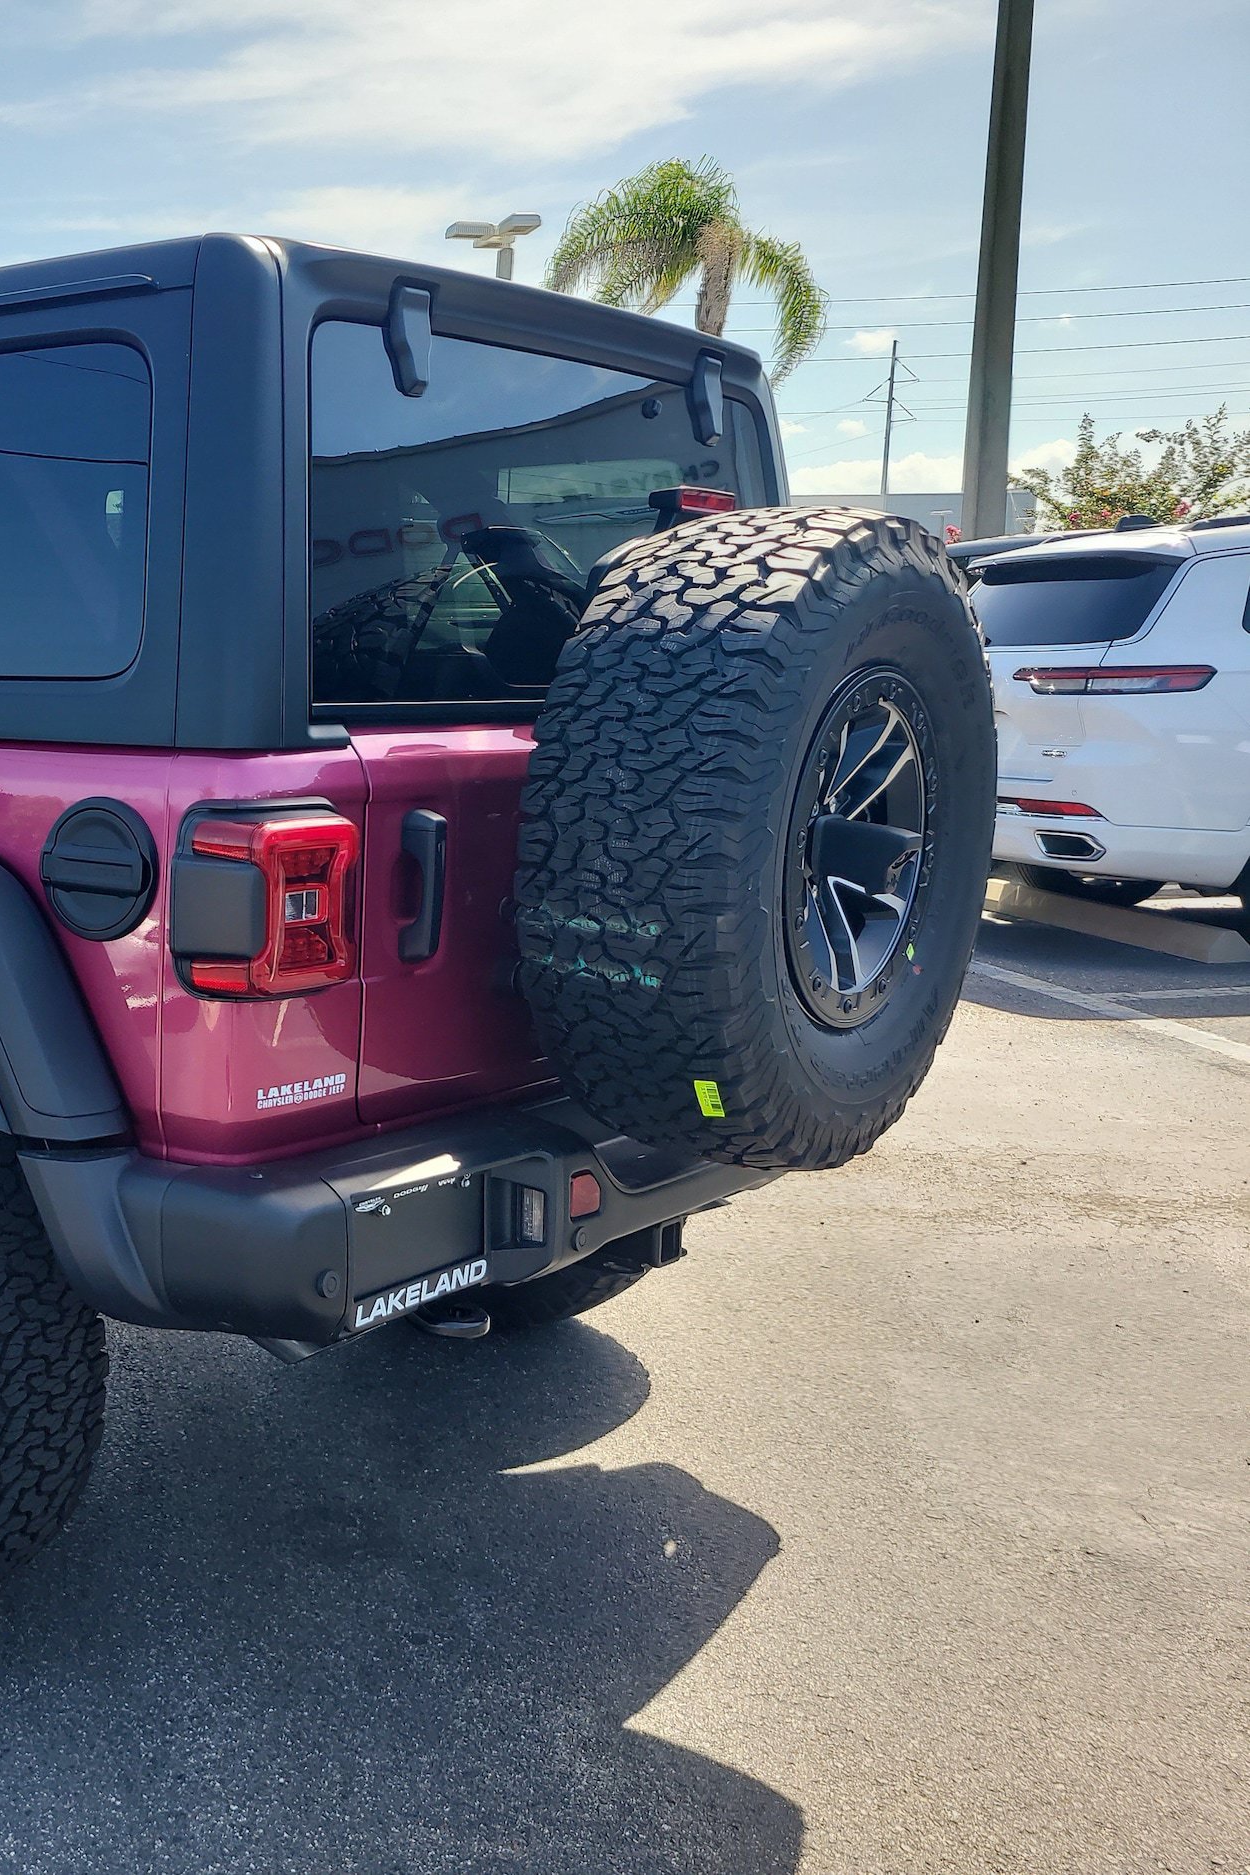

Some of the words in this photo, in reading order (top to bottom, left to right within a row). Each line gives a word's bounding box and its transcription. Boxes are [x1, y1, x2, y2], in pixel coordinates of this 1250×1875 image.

[257, 1073, 347, 1100] LAKELAND
[257, 1096, 294, 1110] CHRYSLER
[303, 1088, 327, 1101] DODGE
[328, 1083, 345, 1096] JEEP
[354, 1258, 488, 1329] LAKELAND
